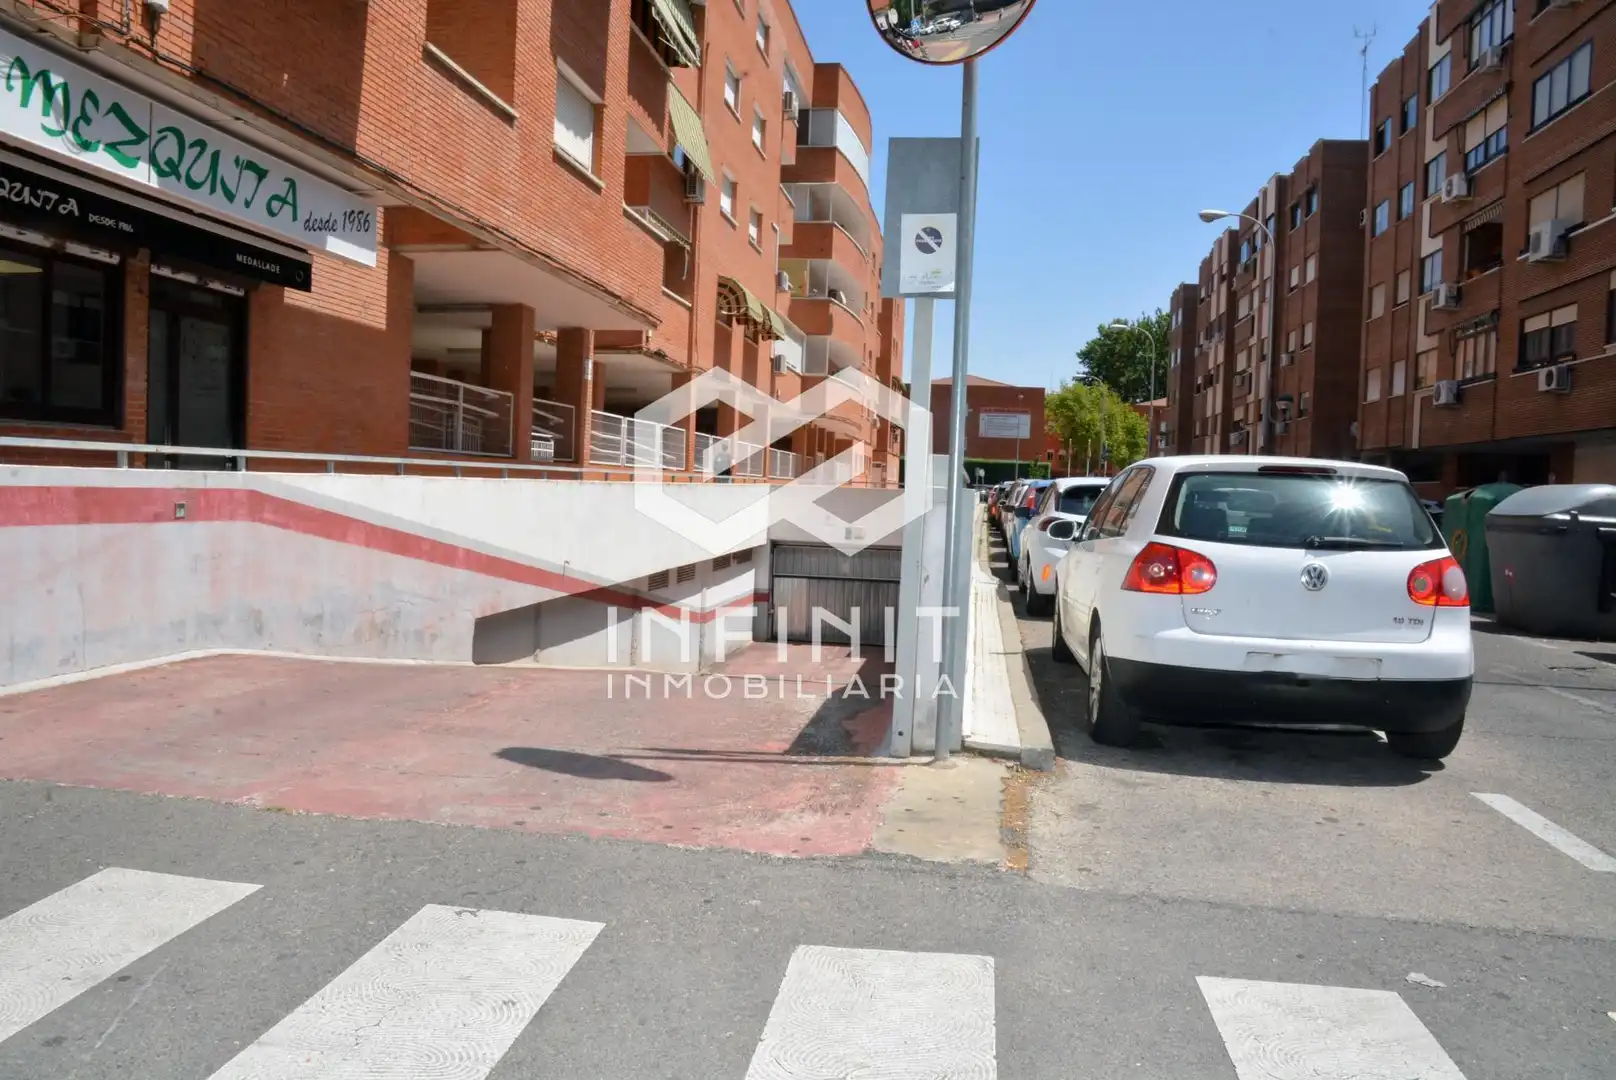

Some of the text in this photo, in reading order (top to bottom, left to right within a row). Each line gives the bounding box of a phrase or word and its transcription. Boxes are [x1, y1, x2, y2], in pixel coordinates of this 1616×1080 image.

[88, 213, 117, 229] DESDE
[304, 211, 338, 232] desde
[342, 210, 371, 232] 1986
